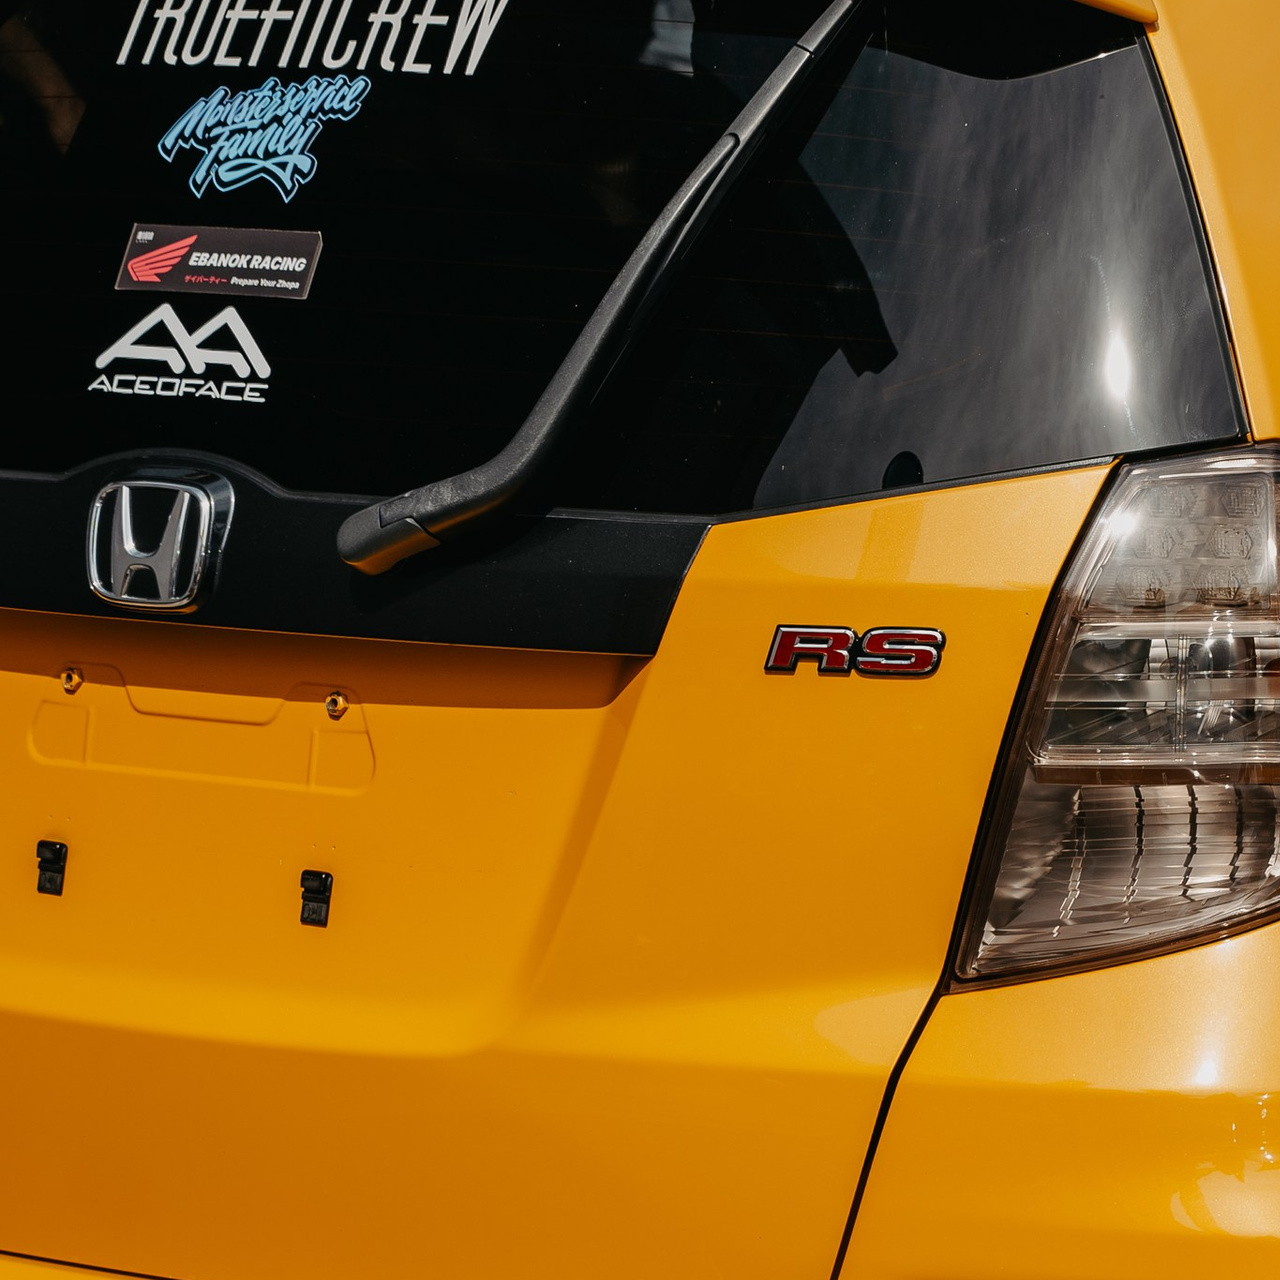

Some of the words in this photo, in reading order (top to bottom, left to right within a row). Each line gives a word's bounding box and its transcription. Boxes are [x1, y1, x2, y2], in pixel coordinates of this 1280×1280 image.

[195, 112, 315, 187] Family
[188, 252, 252, 269] EBANOK
[249, 254, 308, 273] RACING
[230, 276, 259, 287] Prepare
[260, 277, 277, 287] Your
[276, 278, 301, 290] Zhopa
[88, 374, 270, 403] ACEOFACE
[764, 624, 947, 678] RS
